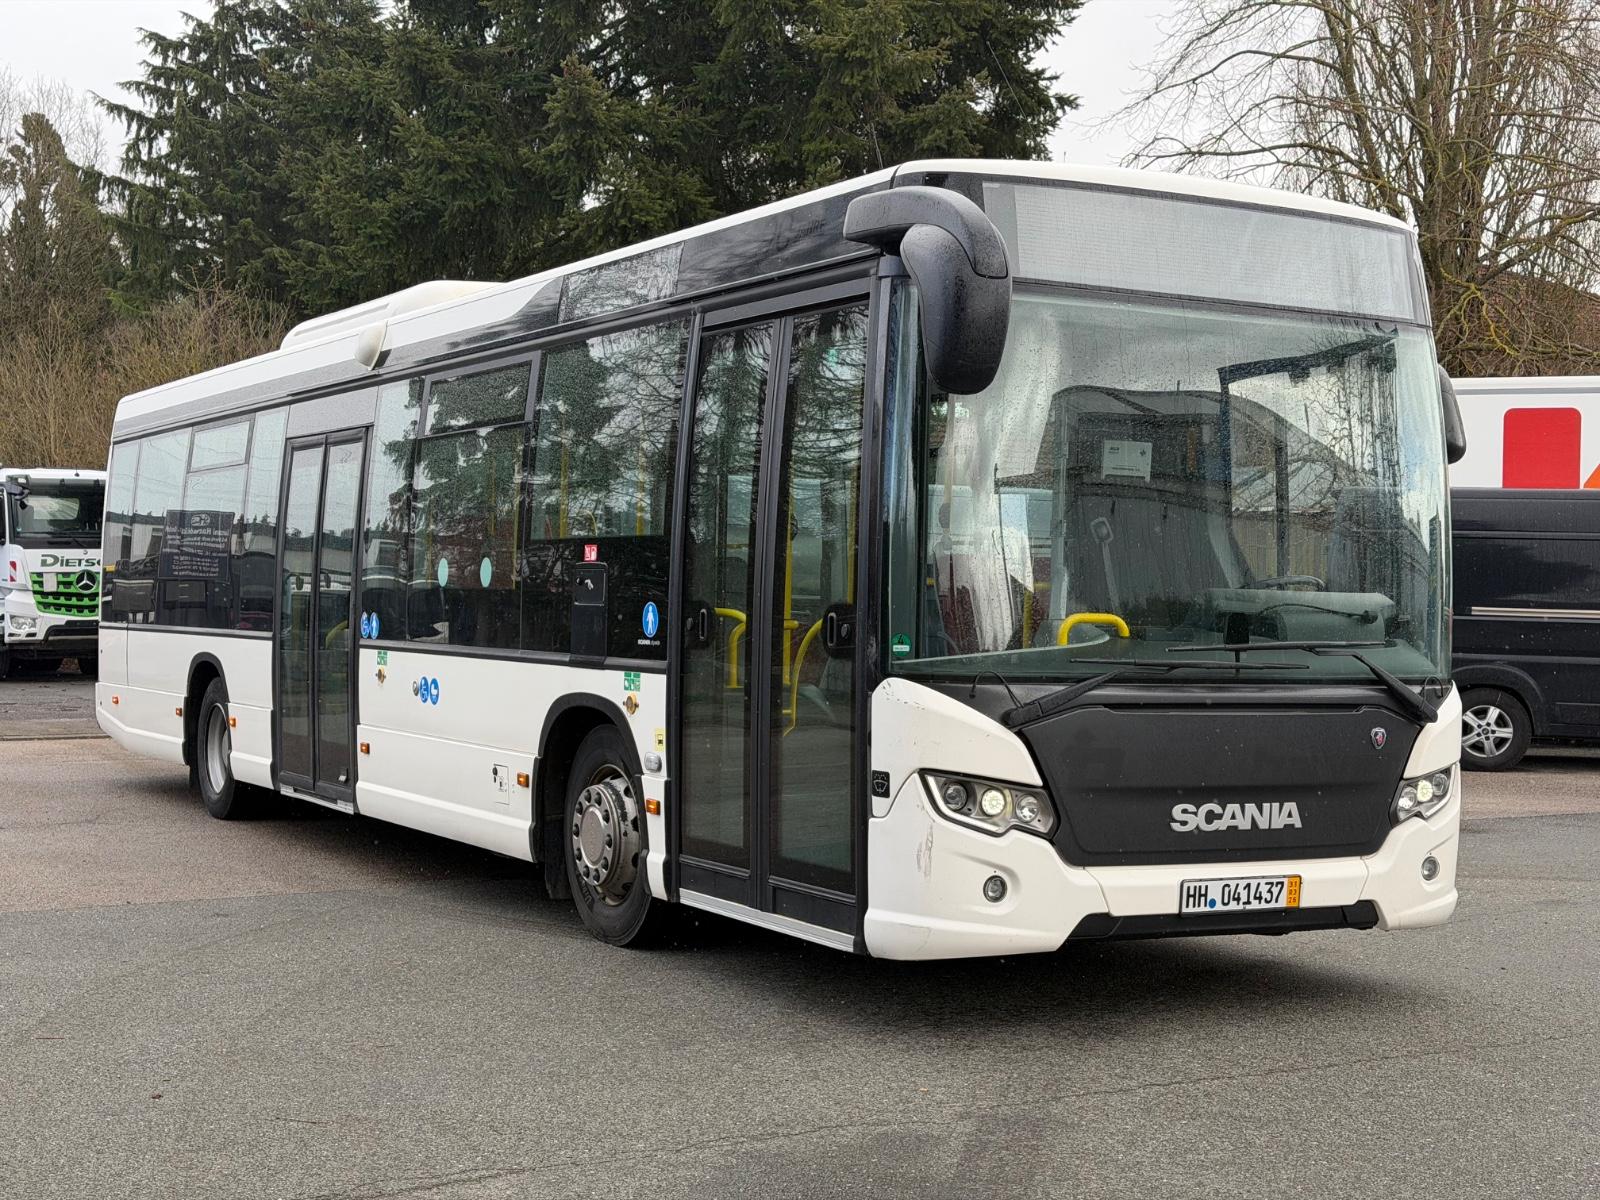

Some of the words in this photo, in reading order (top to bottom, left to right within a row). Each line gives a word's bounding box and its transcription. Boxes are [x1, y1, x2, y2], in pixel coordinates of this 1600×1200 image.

[1170, 802, 1303, 832] SCANIA
[1185, 885, 1209, 908] HH
[1221, 881, 1285, 906] 041437
